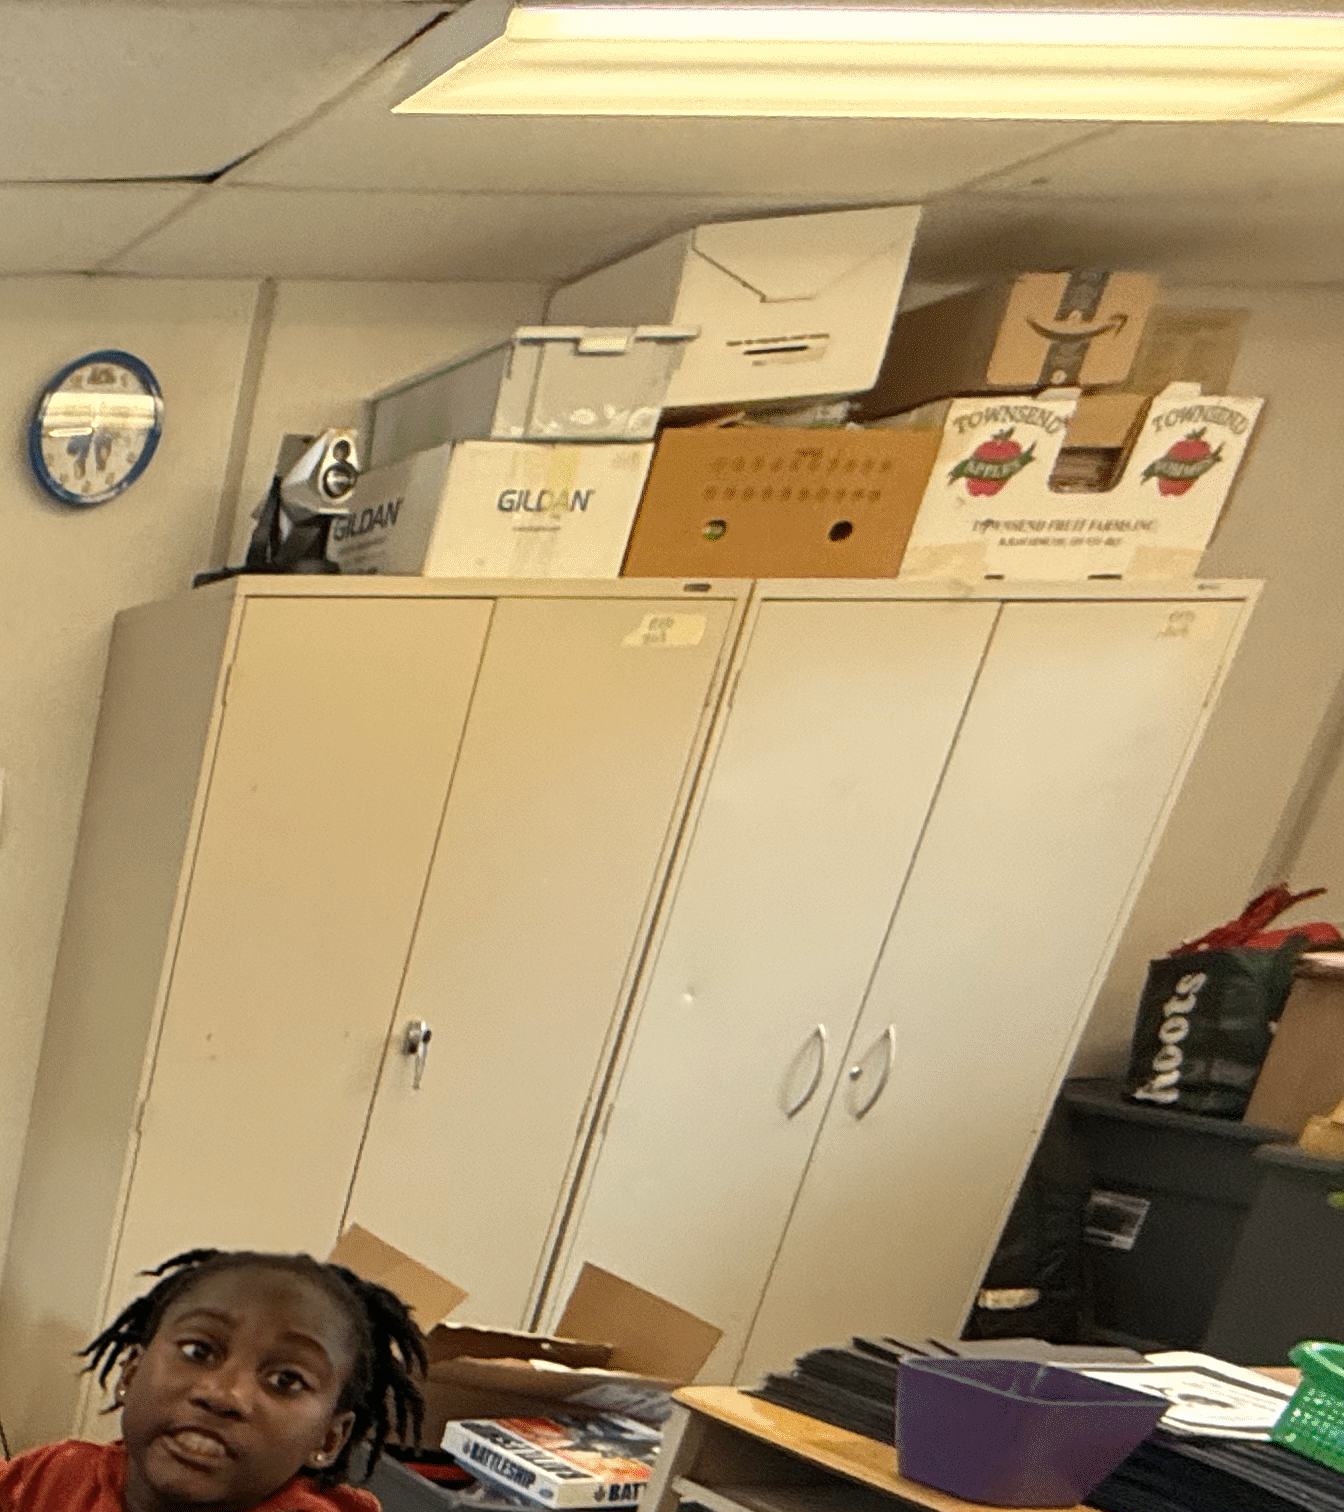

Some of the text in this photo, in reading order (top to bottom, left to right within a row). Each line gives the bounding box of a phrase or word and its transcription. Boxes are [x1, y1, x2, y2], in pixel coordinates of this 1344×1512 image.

[953, 404, 1068, 435] TOWNSEND
[1152, 404, 1249, 435] TOWNSEND
[496, 489, 592, 513] GILDAN
[333, 499, 401, 541] GILDAN
[468, 1441, 537, 1490] BATTLESHIP
